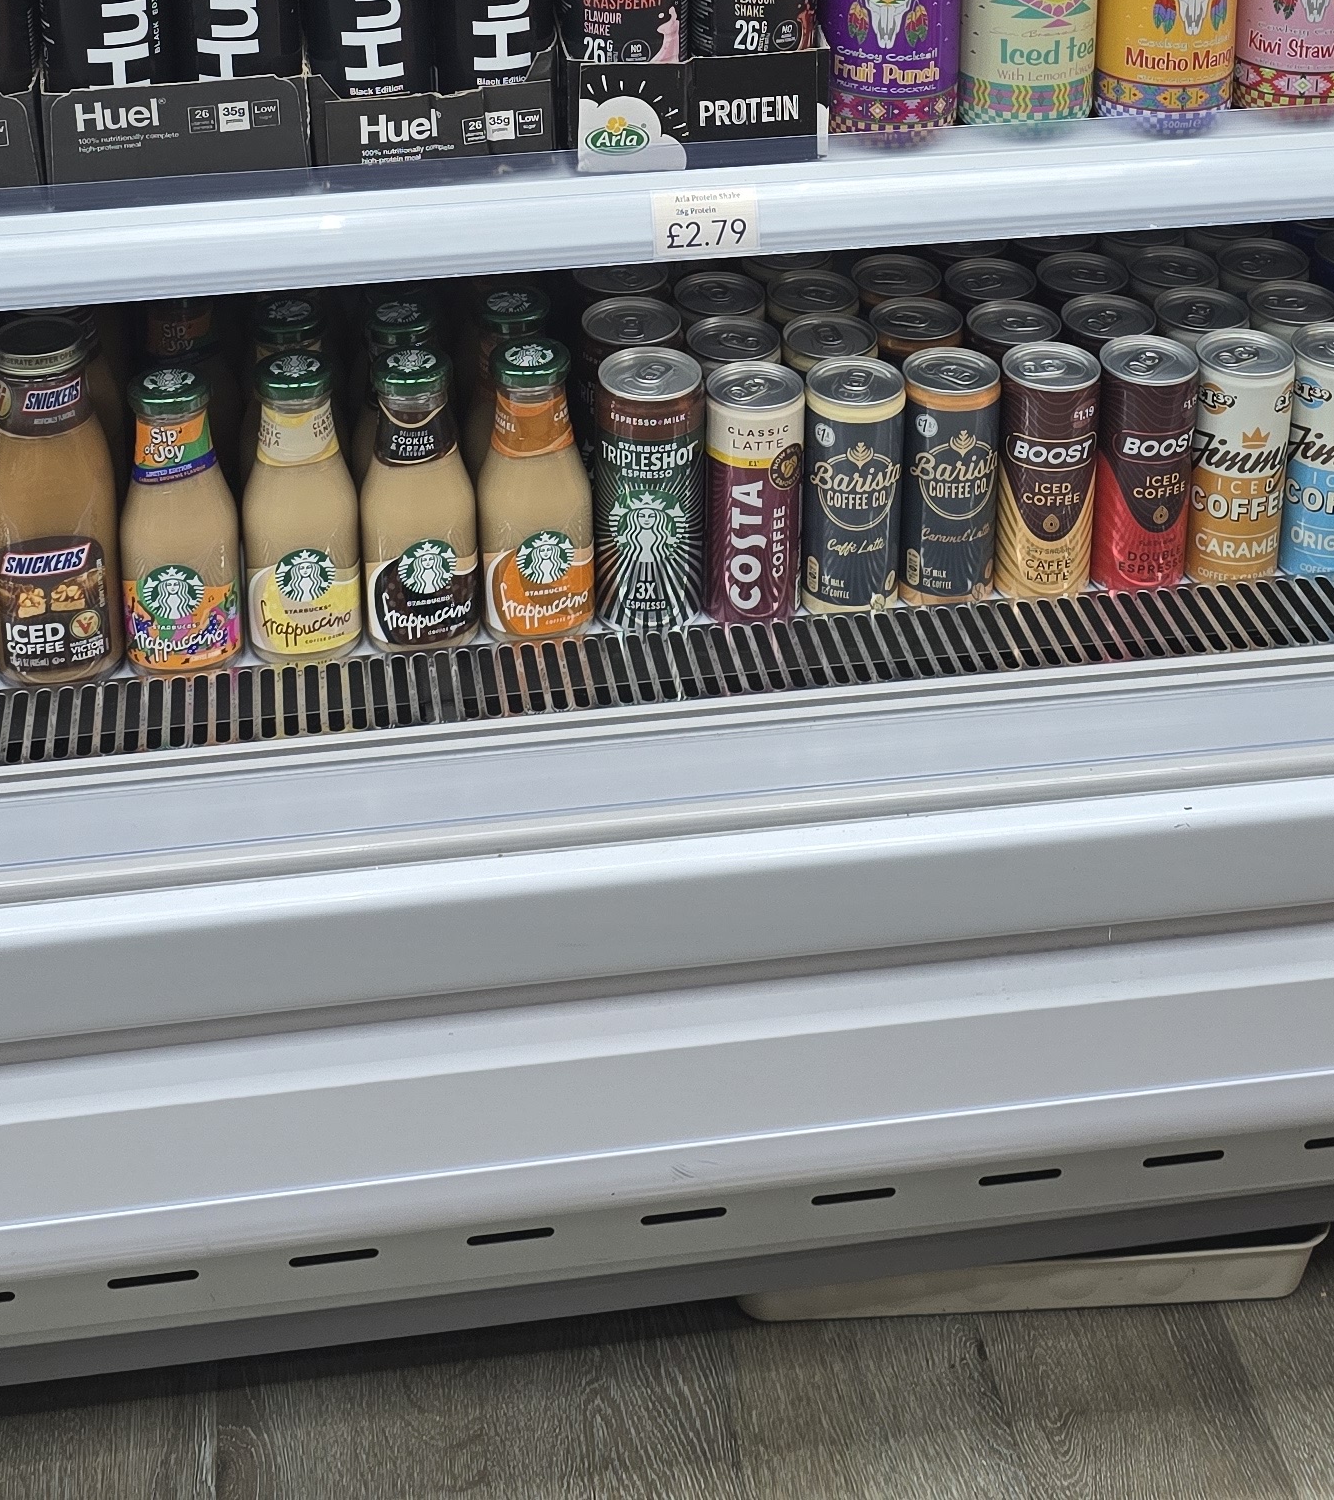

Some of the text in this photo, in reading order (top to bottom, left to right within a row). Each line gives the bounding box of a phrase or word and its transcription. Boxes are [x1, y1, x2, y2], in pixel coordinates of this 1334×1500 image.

[734, 4, 764, 18] SHAKE
[1248, 30, 1282, 57] Kiwi
[834, 58, 940, 83] Fruit Punch
[74, 99, 159, 132] Huel
[699, 96, 798, 125] PROTEIN
[692, 193, 718, 202] Protein
[720, 191, 741, 200] Shake
[690, 205, 716, 214] Protein
[667, 218, 746, 248] £2.79
[151, 428, 178, 444] Sip
[392, 436, 434, 445] COOKIES
[728, 425, 789, 437] CLASSIC
[732, 438, 785, 450] LATTE
[1013, 441, 1092, 461] BOOST
[154, 445, 184, 463] Joy
[622, 469, 672, 478] ESPRESSO
[729, 480, 763, 609] COSTA
[772, 506, 785, 577] COFFEE
[1196, 533, 1279, 558] CARAMEL
[5, 548, 85, 574] SNICKERS
[6, 622, 65, 641] ICED
[7, 639, 64, 654] COFFEE
